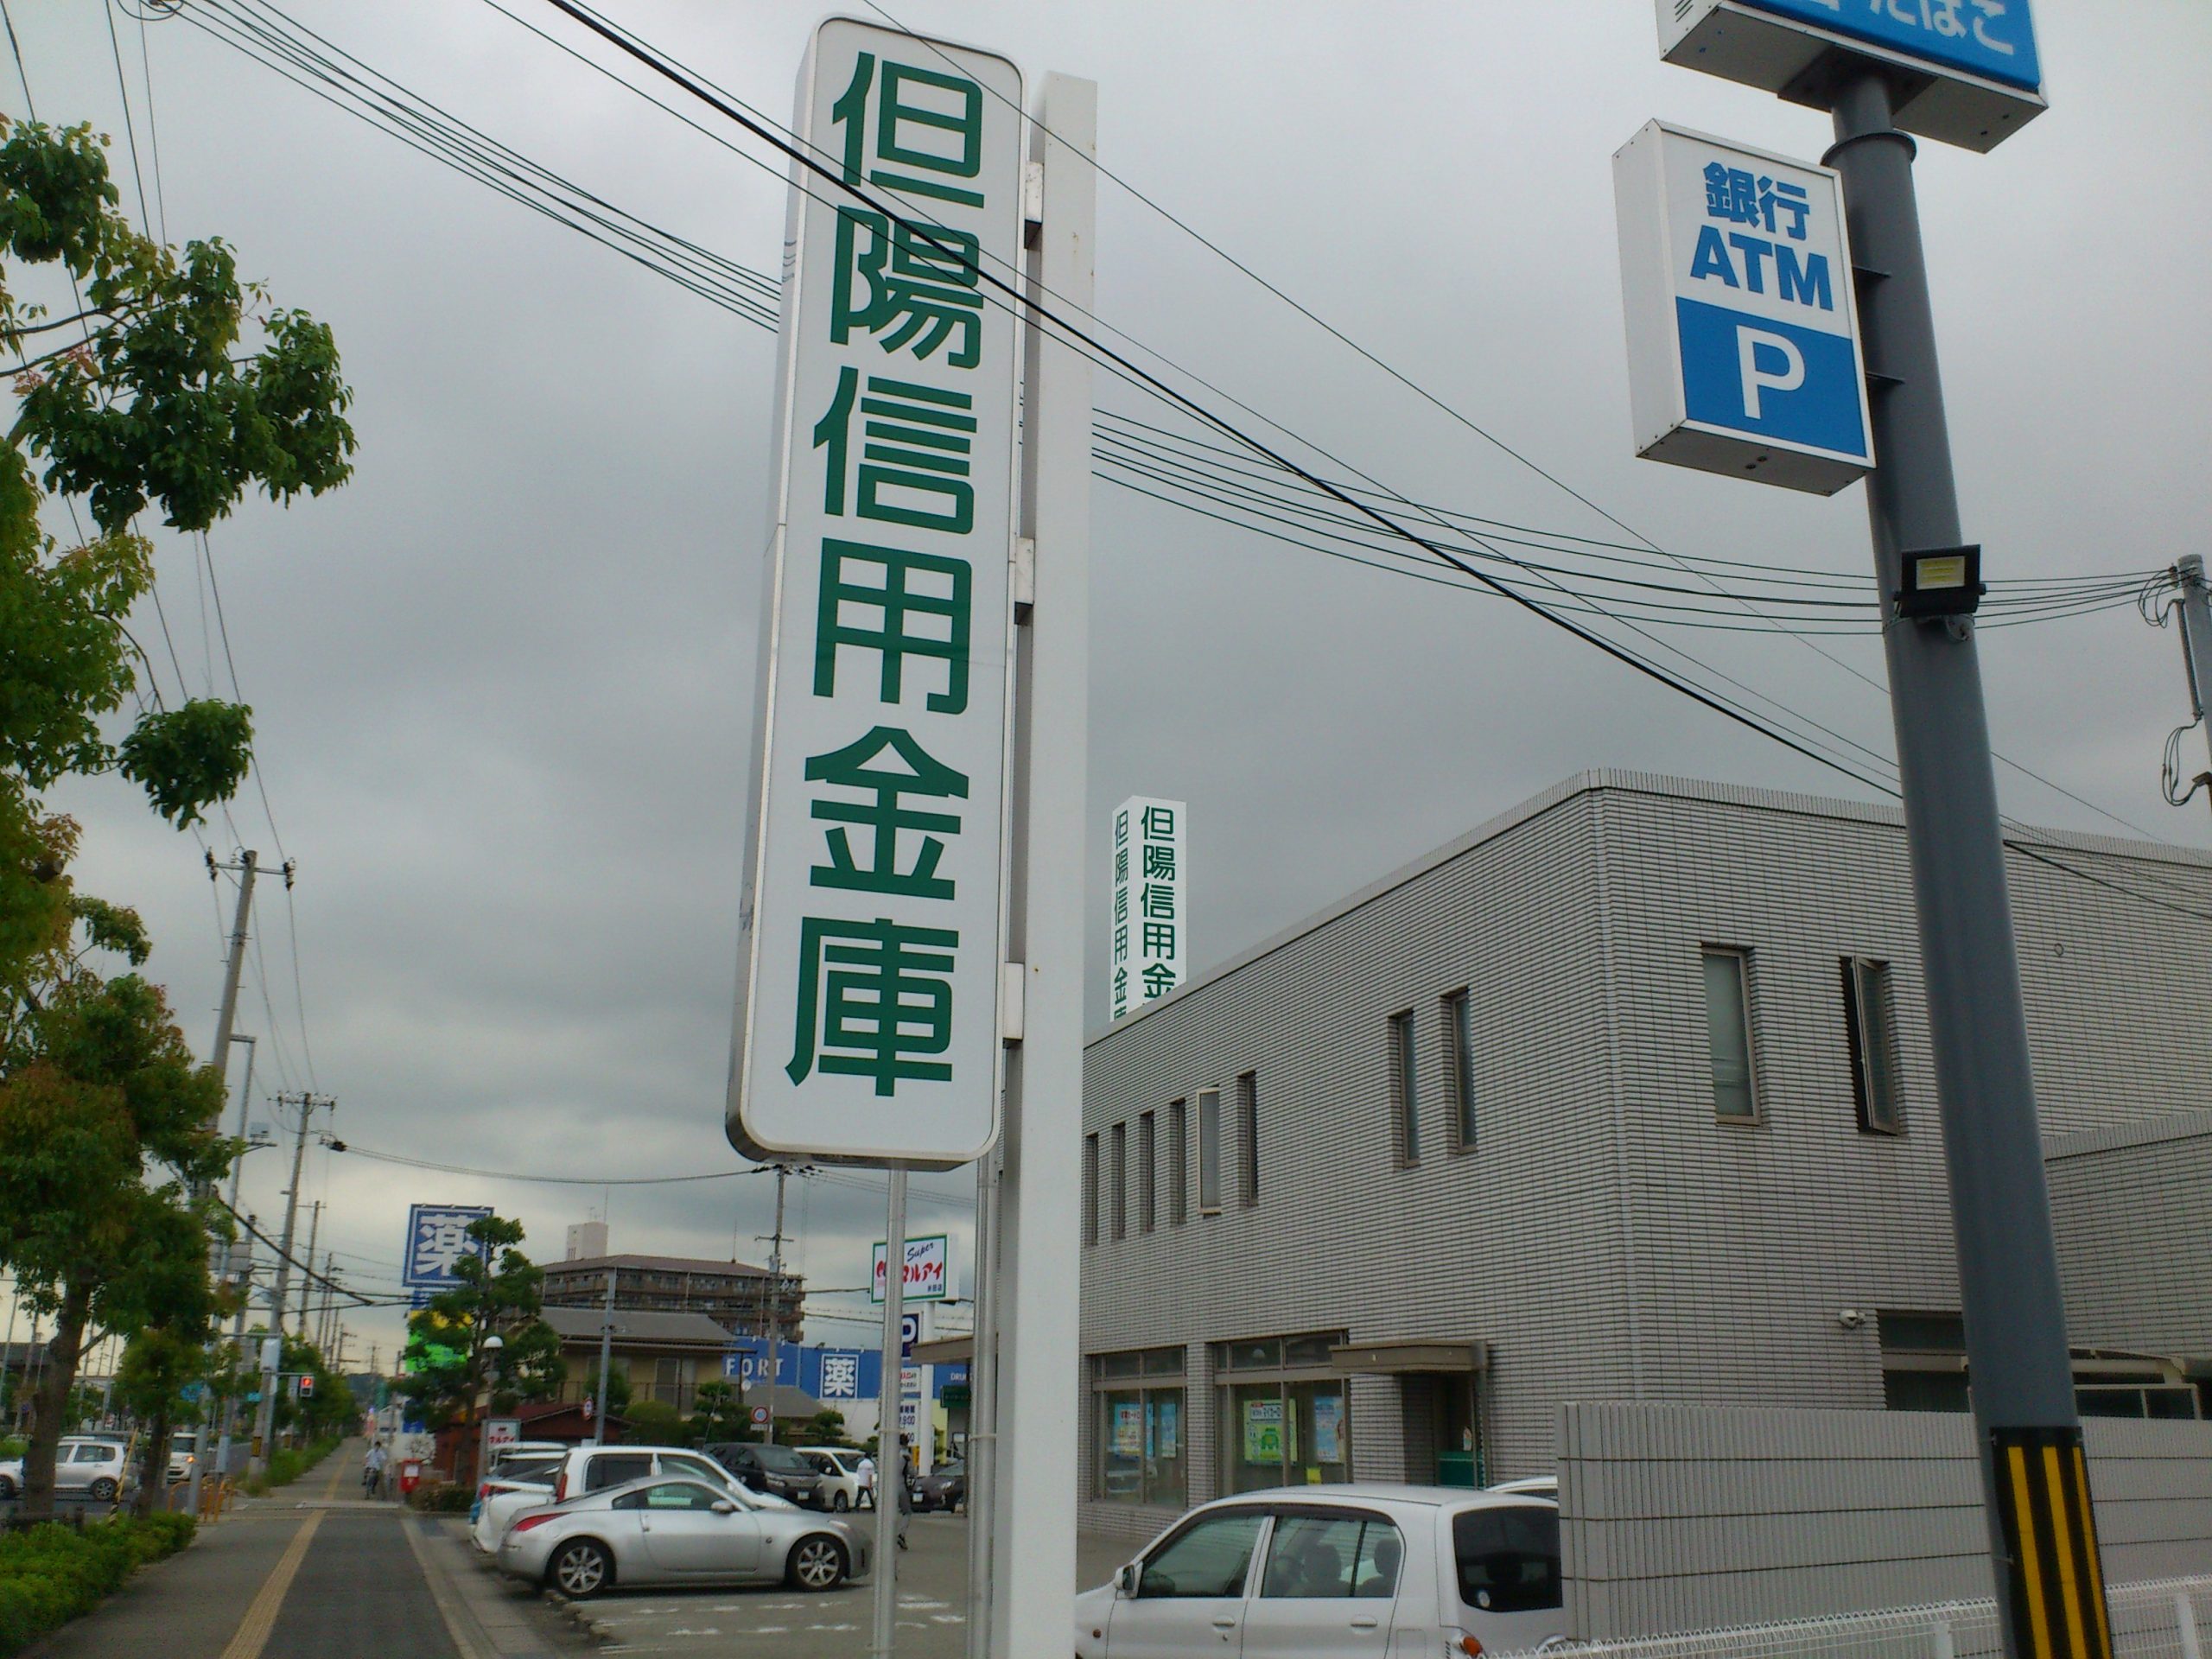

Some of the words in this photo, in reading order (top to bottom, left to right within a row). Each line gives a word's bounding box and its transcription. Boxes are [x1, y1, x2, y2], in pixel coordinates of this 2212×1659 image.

[1702, 162, 1811, 241] 銀行
[1689, 224, 1834, 312] ATM
[1736, 324, 1806, 420] P
[785, 51, 985, 1096] 但陽信用金庫
[415, 1214, 480, 1277] 薬
[906, 1243, 934, 1262] Super
[725, 1357, 784, 1377] FORT
[823, 1357, 855, 1397] 薬
